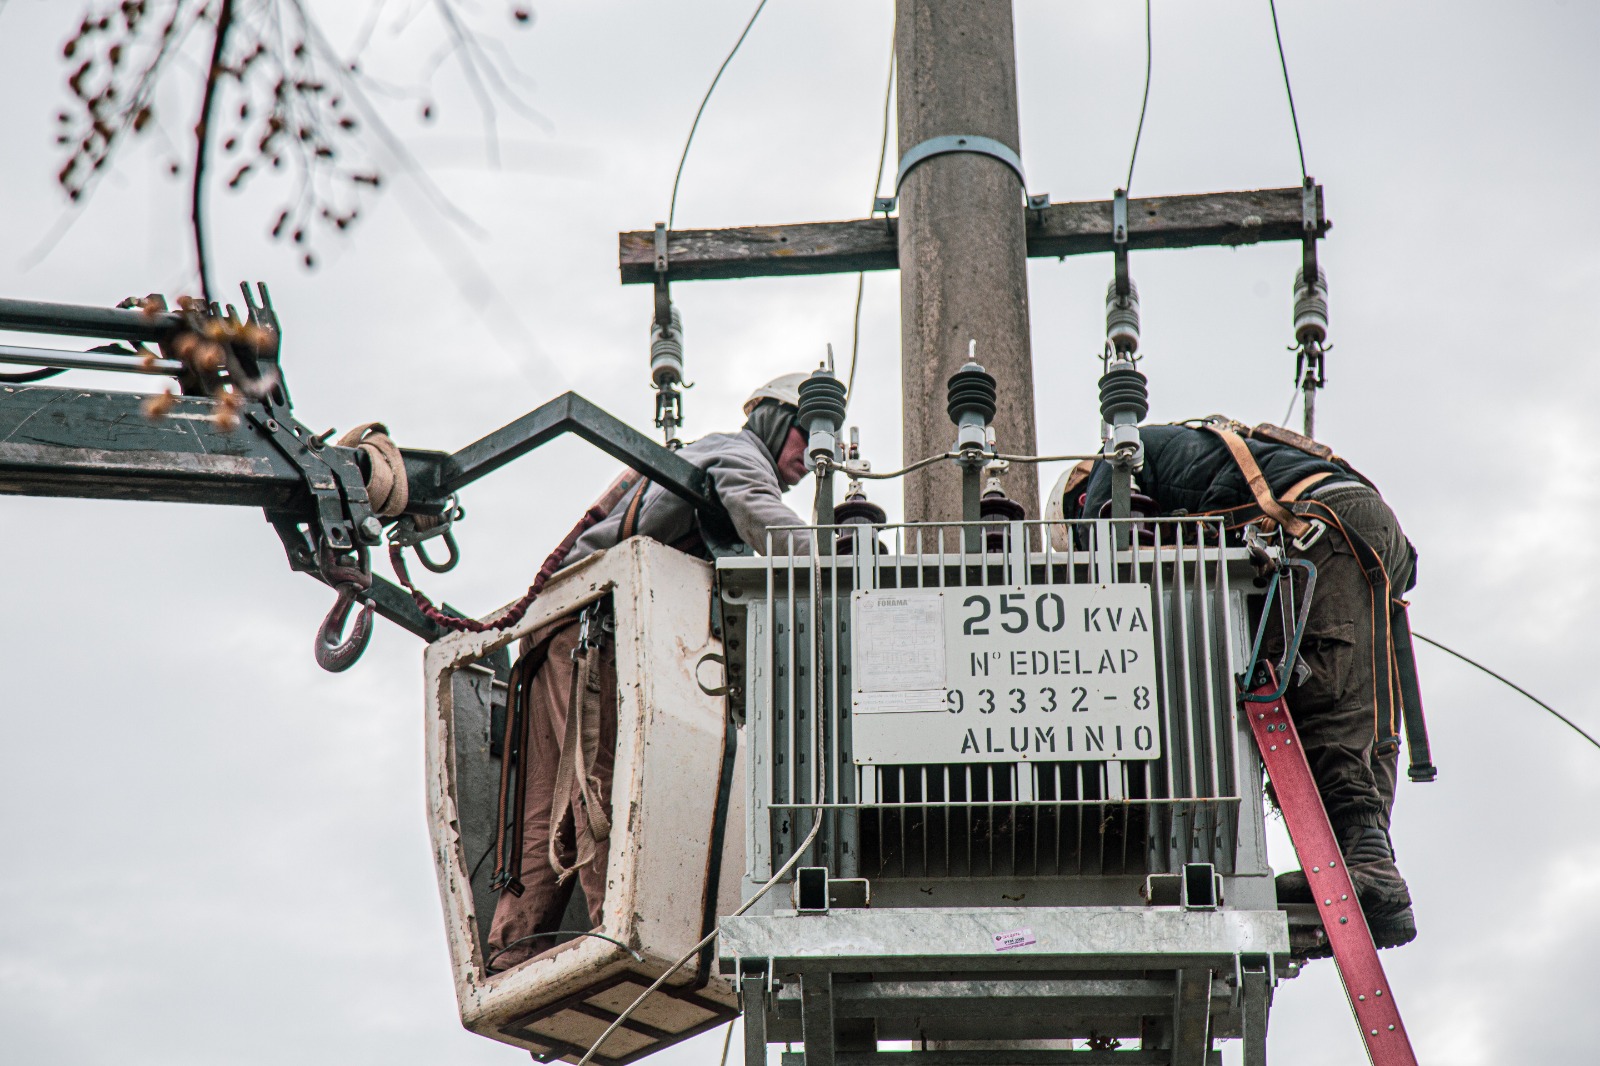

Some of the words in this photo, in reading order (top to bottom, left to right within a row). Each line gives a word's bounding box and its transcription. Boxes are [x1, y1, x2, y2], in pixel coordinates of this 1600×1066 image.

[963, 592, 1066, 636] 250
[1084, 607, 1148, 632] KVA
[1010, 649, 1139, 675] EDELAP
[946, 685, 1150, 714] 93332-8
[960, 725, 1153, 754] ALUMINIO
